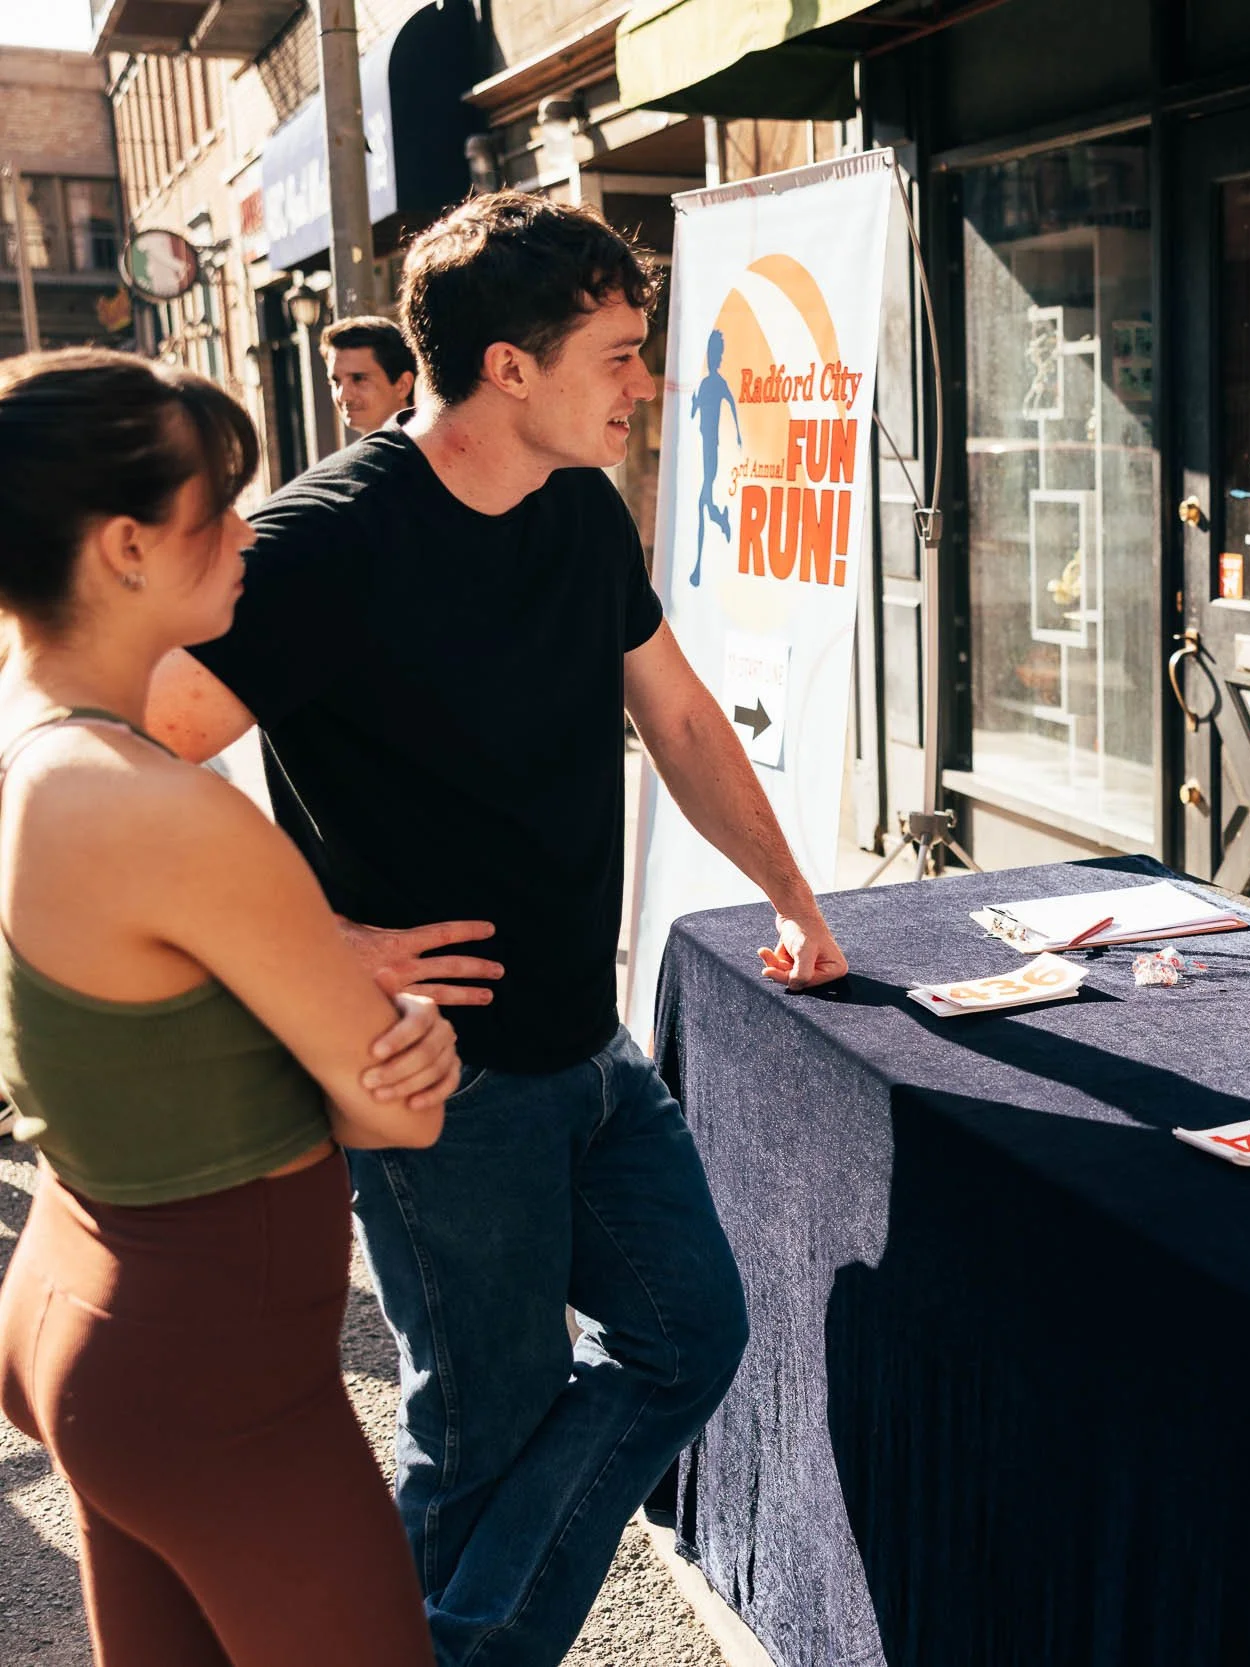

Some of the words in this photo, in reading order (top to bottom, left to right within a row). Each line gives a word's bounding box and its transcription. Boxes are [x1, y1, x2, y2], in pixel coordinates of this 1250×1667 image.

[738, 363, 815, 404] Radford
[820, 360, 863, 410] City
[786, 419, 858, 484] FUN
[729, 458, 749, 496] 3rd
[750, 458, 785, 480] Annual
[738, 485, 852, 588] RUN!
[950, 963, 1069, 1001] 436
